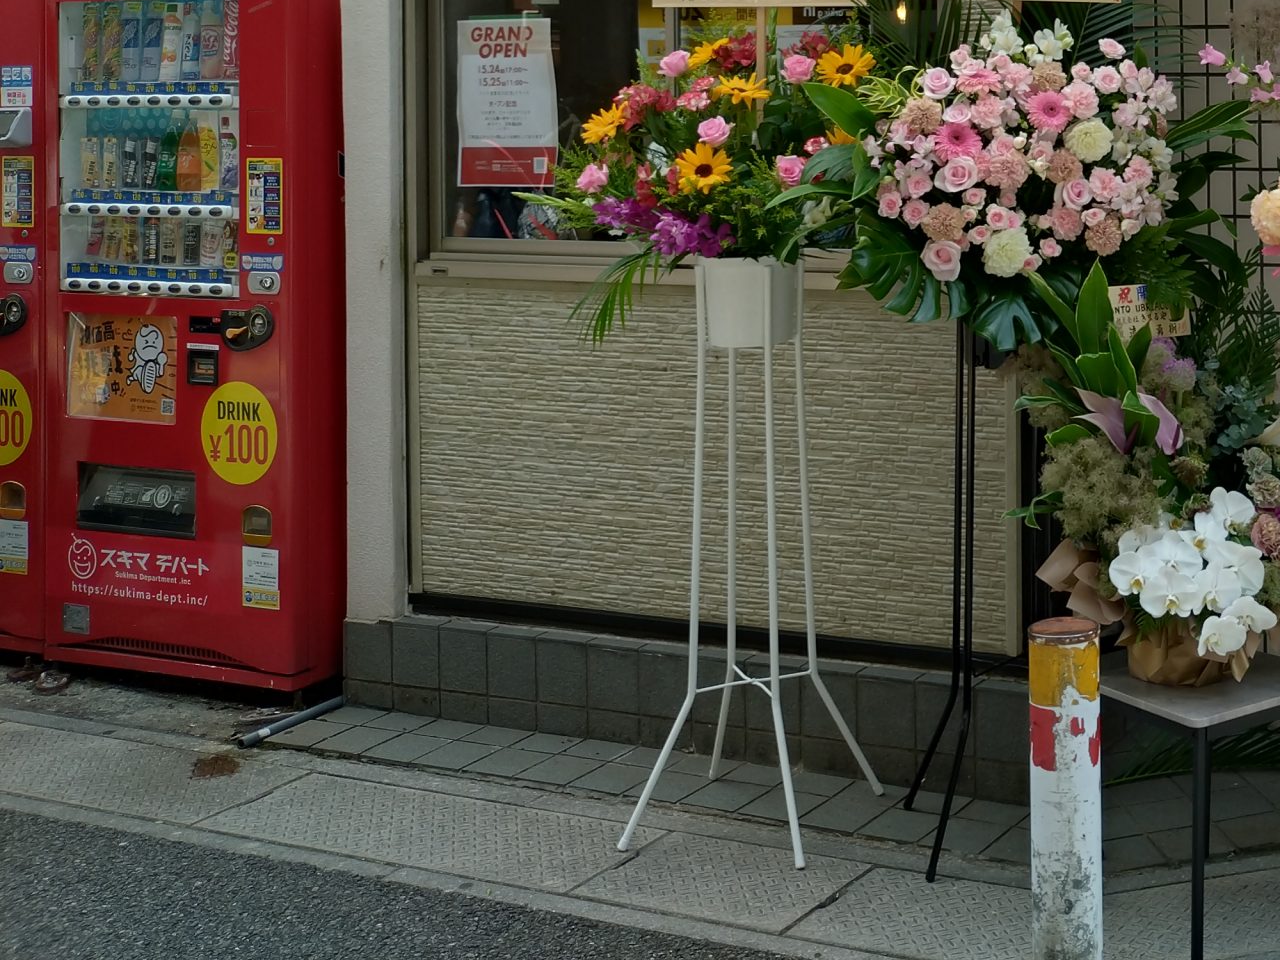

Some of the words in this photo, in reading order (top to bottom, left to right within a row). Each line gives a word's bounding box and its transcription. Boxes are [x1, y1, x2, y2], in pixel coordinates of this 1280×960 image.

[470, 25, 533, 43] GRAND
[478, 42, 528, 59] OPEN
[217, 400, 262, 422] DRINK
[209, 423, 269, 465] ¥100
[100, 548, 151, 571] スキマ
[156, 554, 210, 577] デパート
[115, 570, 138, 580] Sukima
[139, 573, 177, 584] Department
[71, 580, 209, 607] https://sukima-dept.inc/
